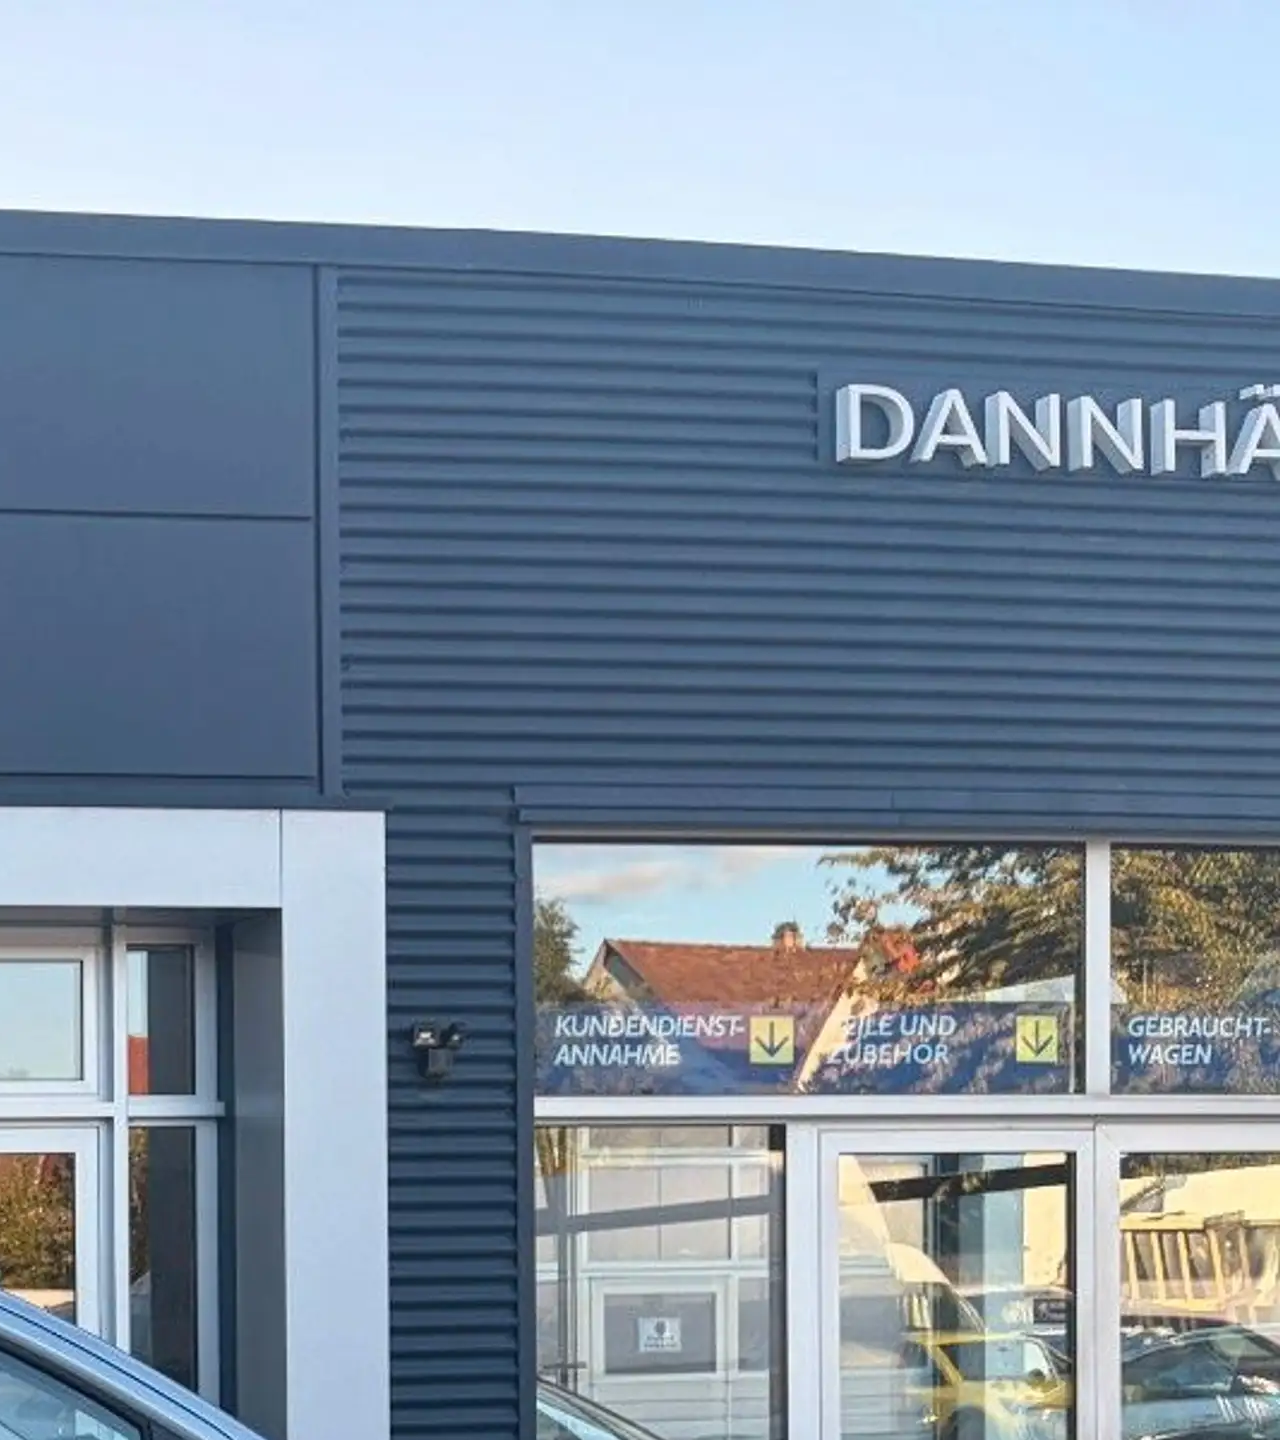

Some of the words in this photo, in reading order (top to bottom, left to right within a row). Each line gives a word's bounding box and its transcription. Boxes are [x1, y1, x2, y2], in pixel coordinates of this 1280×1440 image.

[554, 1014, 746, 1038] KUNDENDIENST-
[899, 1013, 958, 1038] UND
[1128, 1016, 1271, 1037] GEBRAUCHT-
[553, 1042, 681, 1067] ANNAHME
[1127, 1043, 1213, 1066] WAGEN
